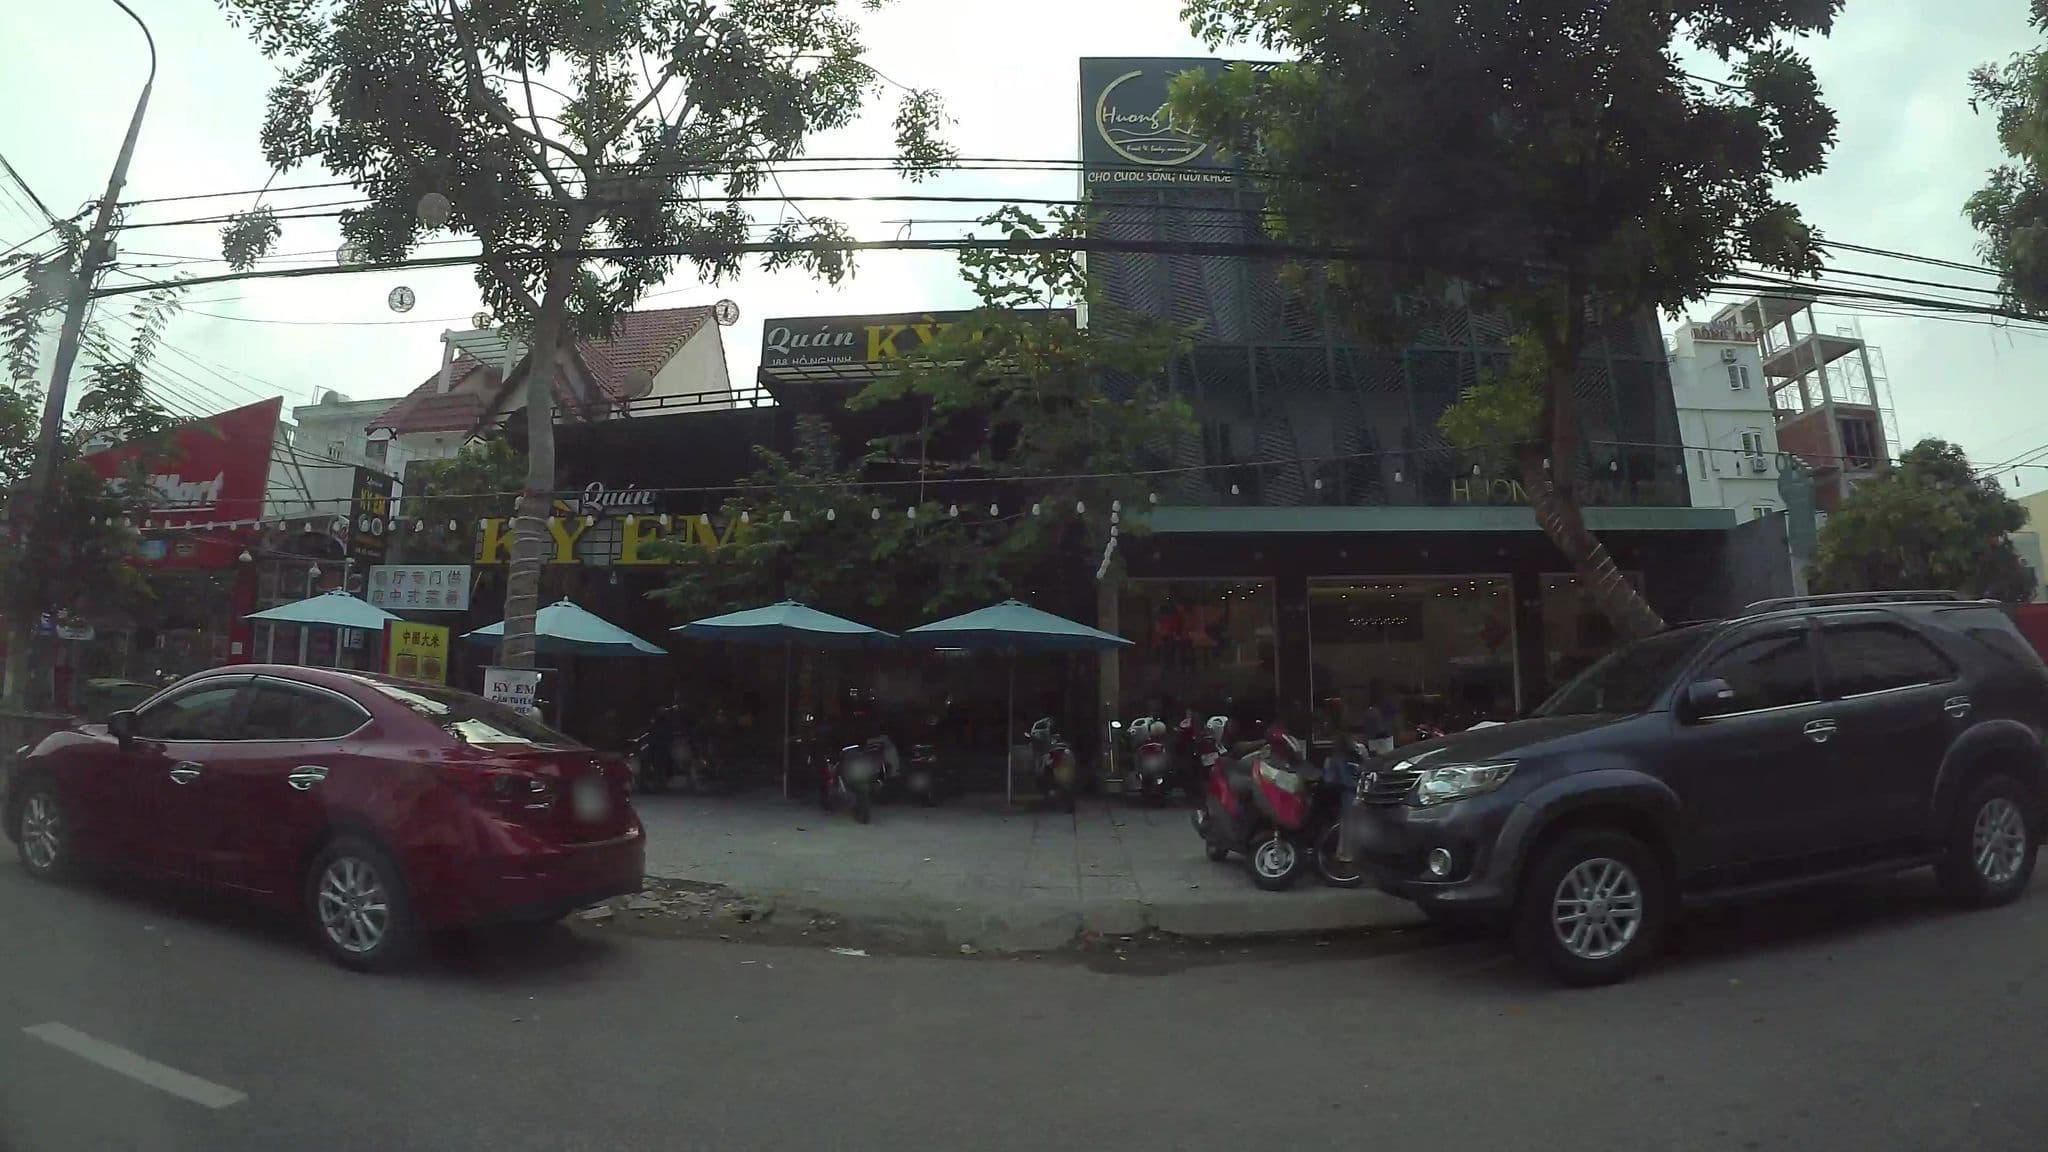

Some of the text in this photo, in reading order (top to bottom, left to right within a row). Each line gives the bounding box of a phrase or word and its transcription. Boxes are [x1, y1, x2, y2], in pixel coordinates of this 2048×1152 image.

[1088, 171, 1111, 182] CHO
[768, 325, 856, 355] Quán
[582, 481, 654, 512] Quán
[612, 513, 756, 564] EM
